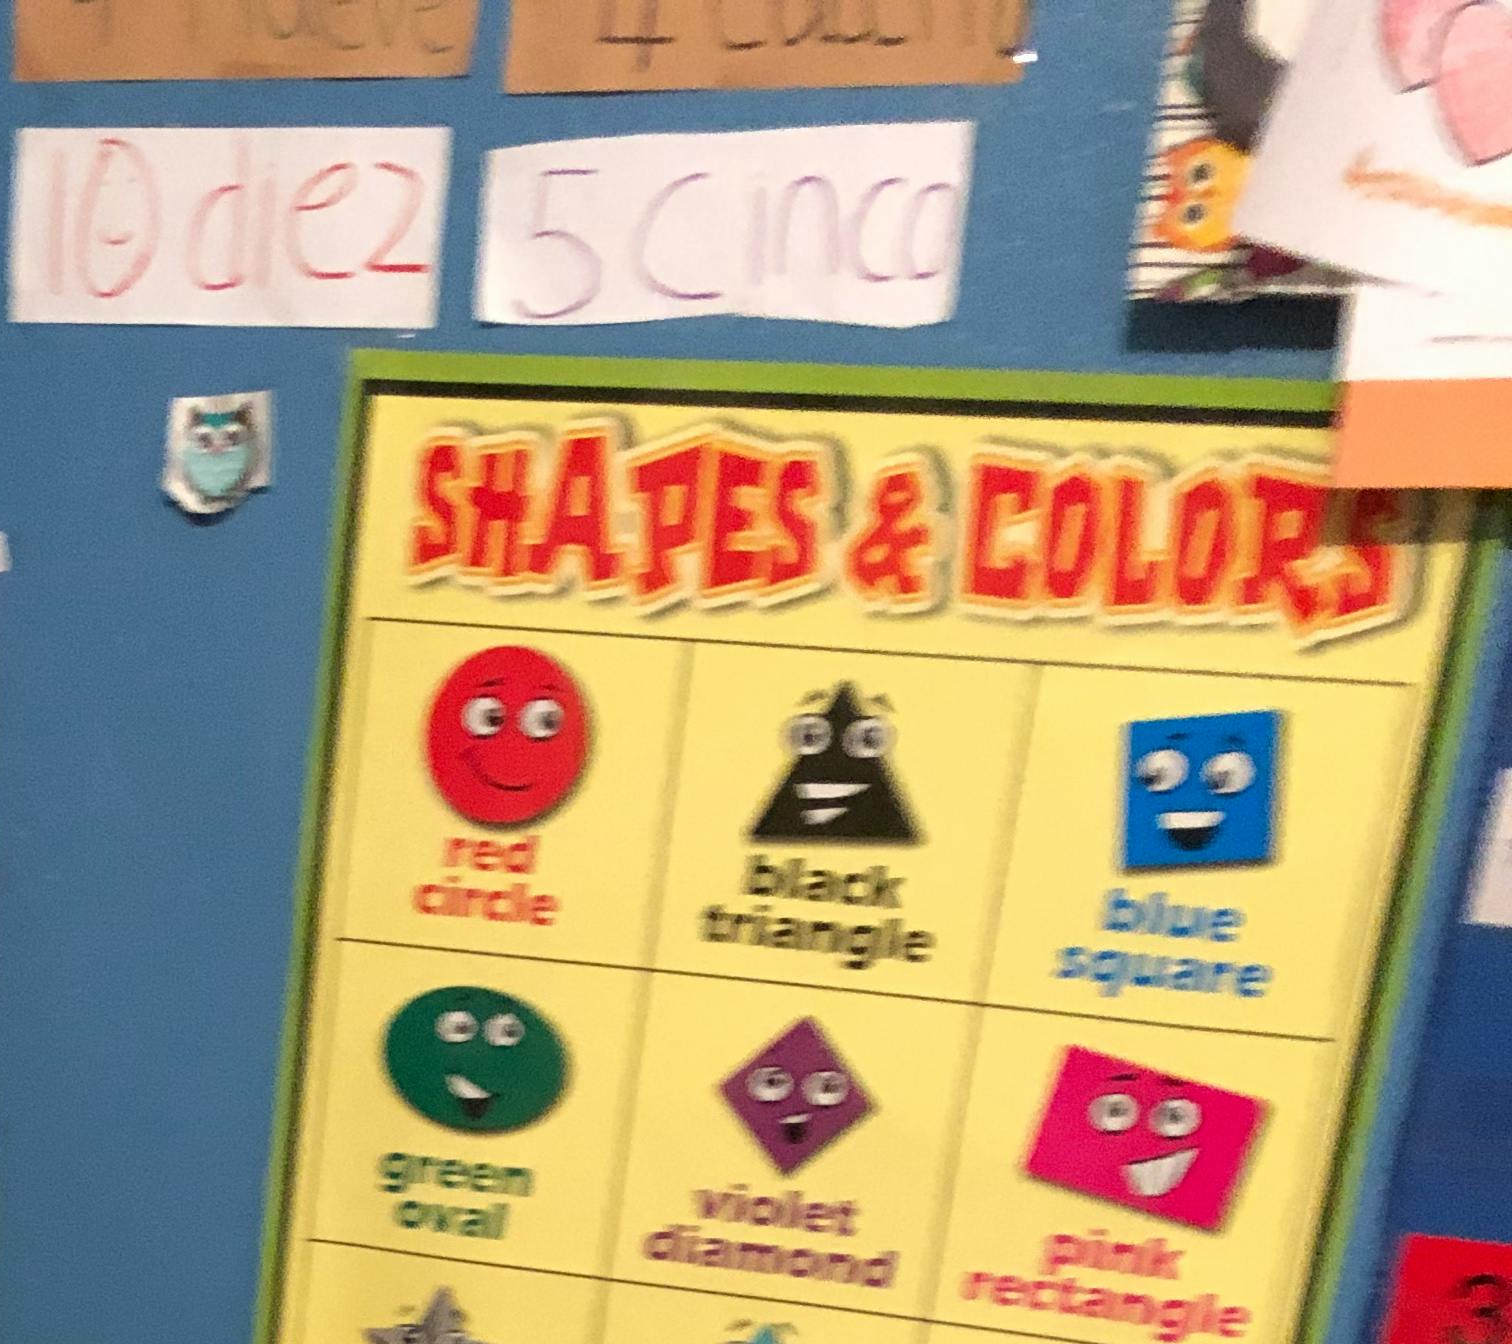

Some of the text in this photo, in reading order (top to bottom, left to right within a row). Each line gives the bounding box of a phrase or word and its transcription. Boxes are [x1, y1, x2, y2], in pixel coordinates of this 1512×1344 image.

[46, 138, 164, 299] 10
[514, 168, 604, 320] 5
[407, 422, 1404, 642] SHAPES & COLORS
[442, 834, 541, 875] red
[742, 854, 908, 908] black
[412, 876, 560, 926] circle
[1099, 887, 1246, 943] blue
[698, 904, 937, 970] triangle
[1050, 945, 1274, 998] square
[377, 1151, 537, 1196] green
[393, 1200, 512, 1240] oval
[692, 1183, 861, 1237] violet
[642, 1224, 901, 1289] diamond
[1039, 1228, 1186, 1281] pink
[958, 1271, 1253, 1344] rectangle
